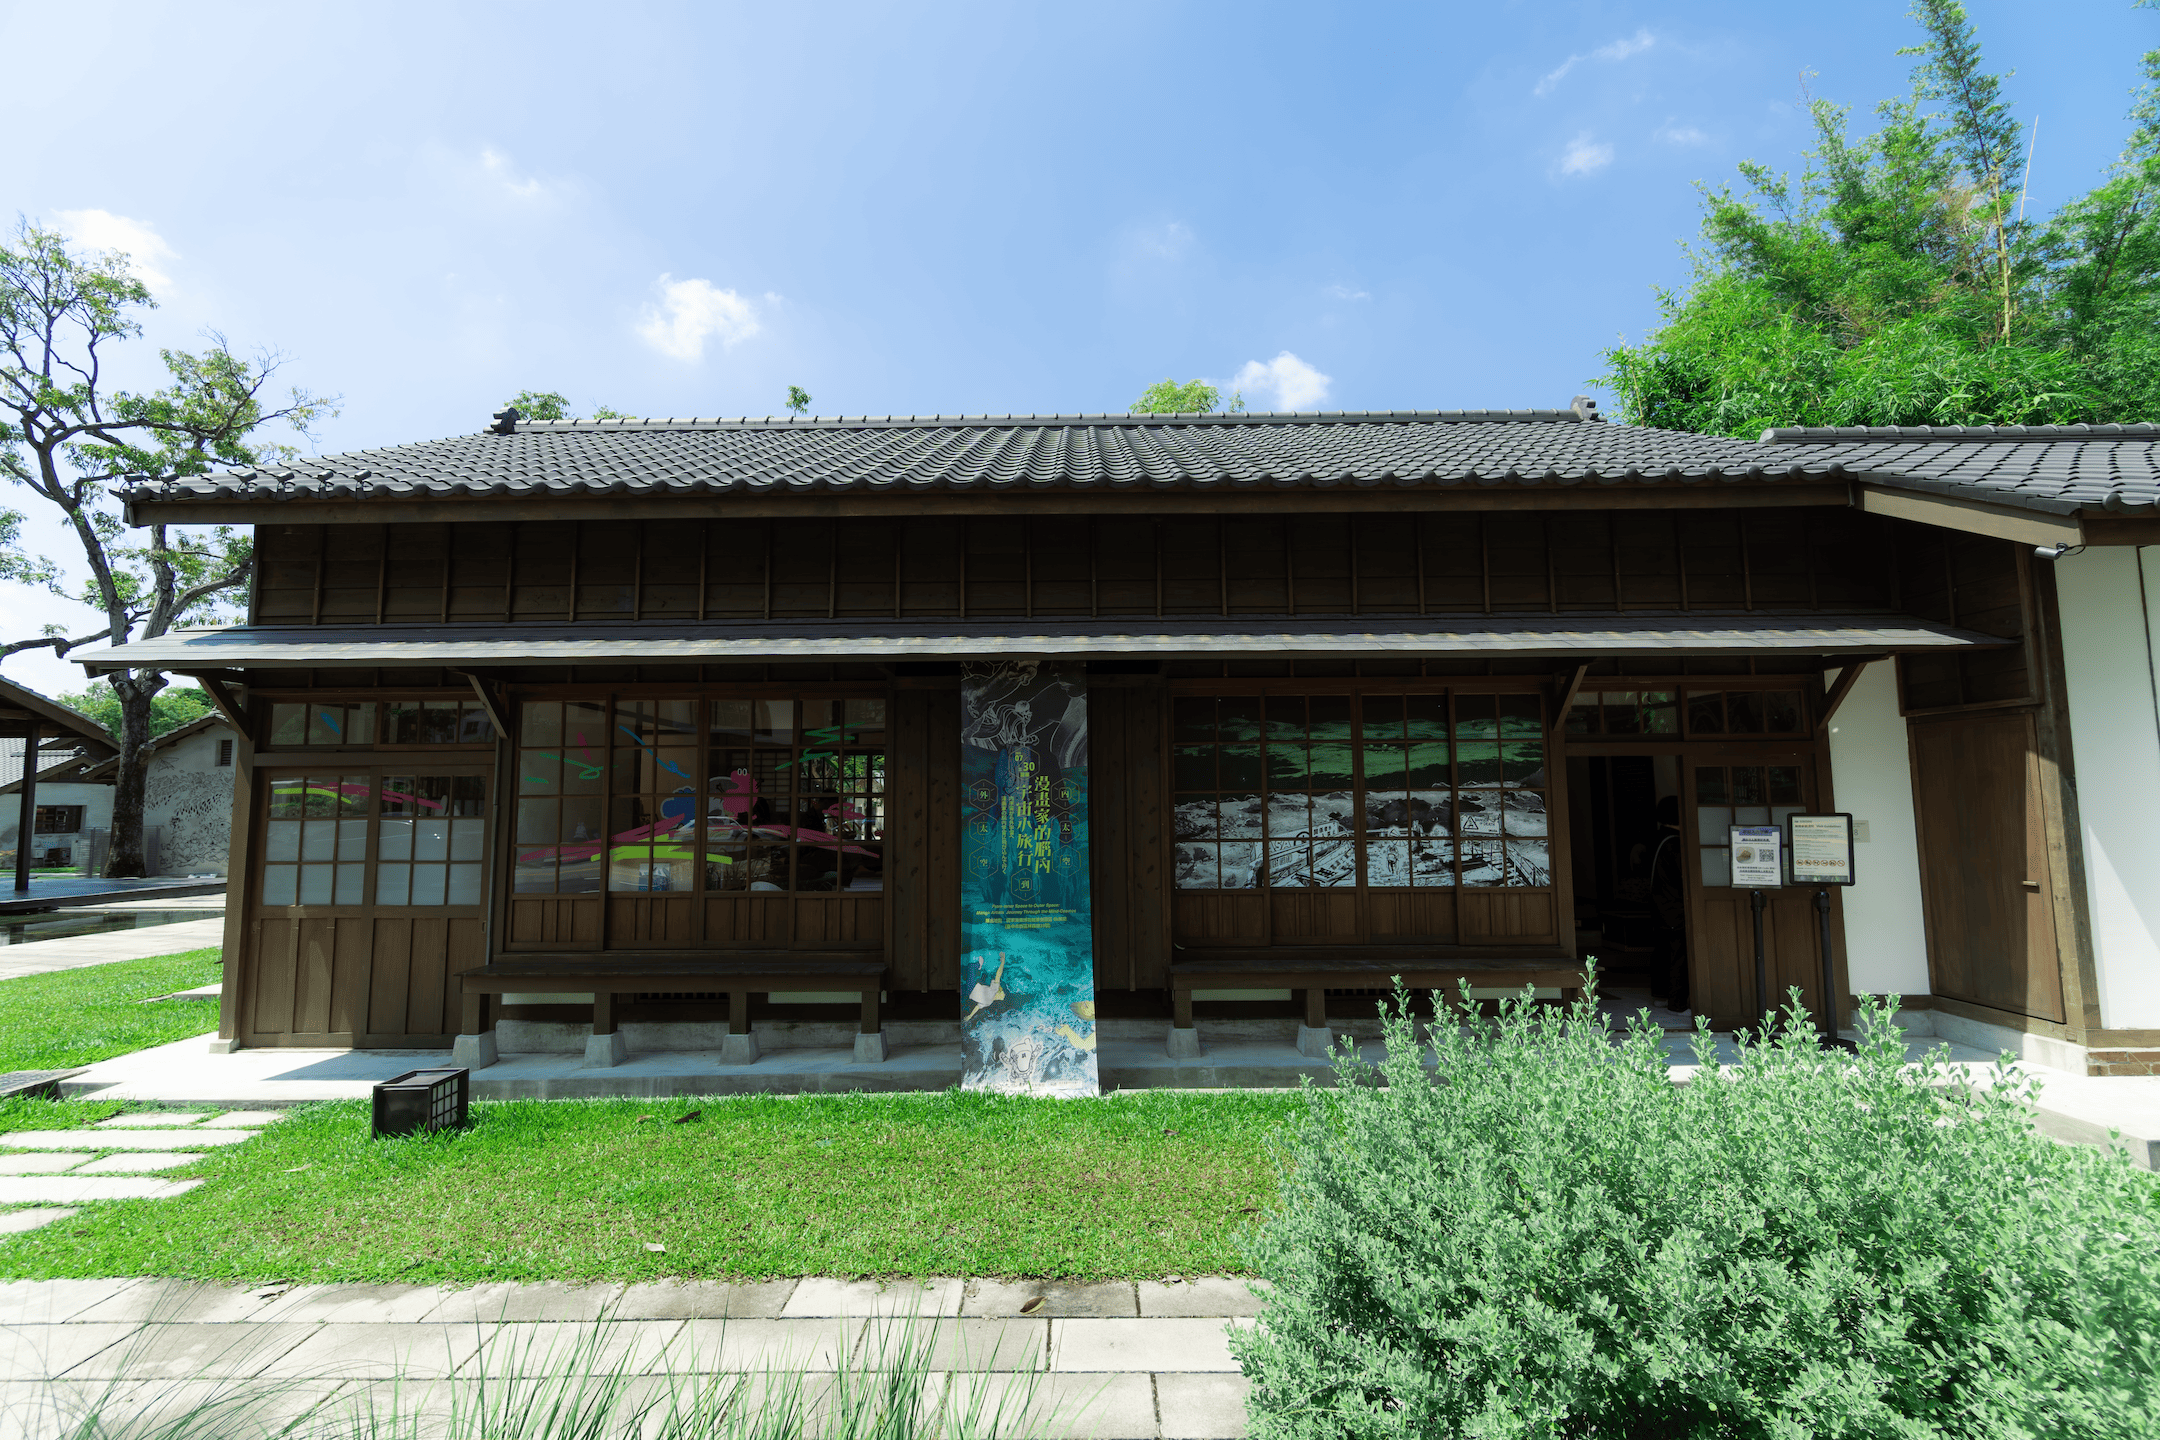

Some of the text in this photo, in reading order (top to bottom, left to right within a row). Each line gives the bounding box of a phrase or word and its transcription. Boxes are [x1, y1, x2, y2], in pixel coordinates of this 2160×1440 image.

[1014, 754, 1023, 762] 07
[1023, 761, 1036, 772] 30
[979, 790, 988, 799] 外
[979, 824, 988, 833] 太
[1016, 784, 1033, 867] 宇宙小旅行
[1034, 775, 1051, 874] 漫畫家的腦內
[1062, 823, 1071, 832] 太
[1021, 879, 1030, 889] 到
